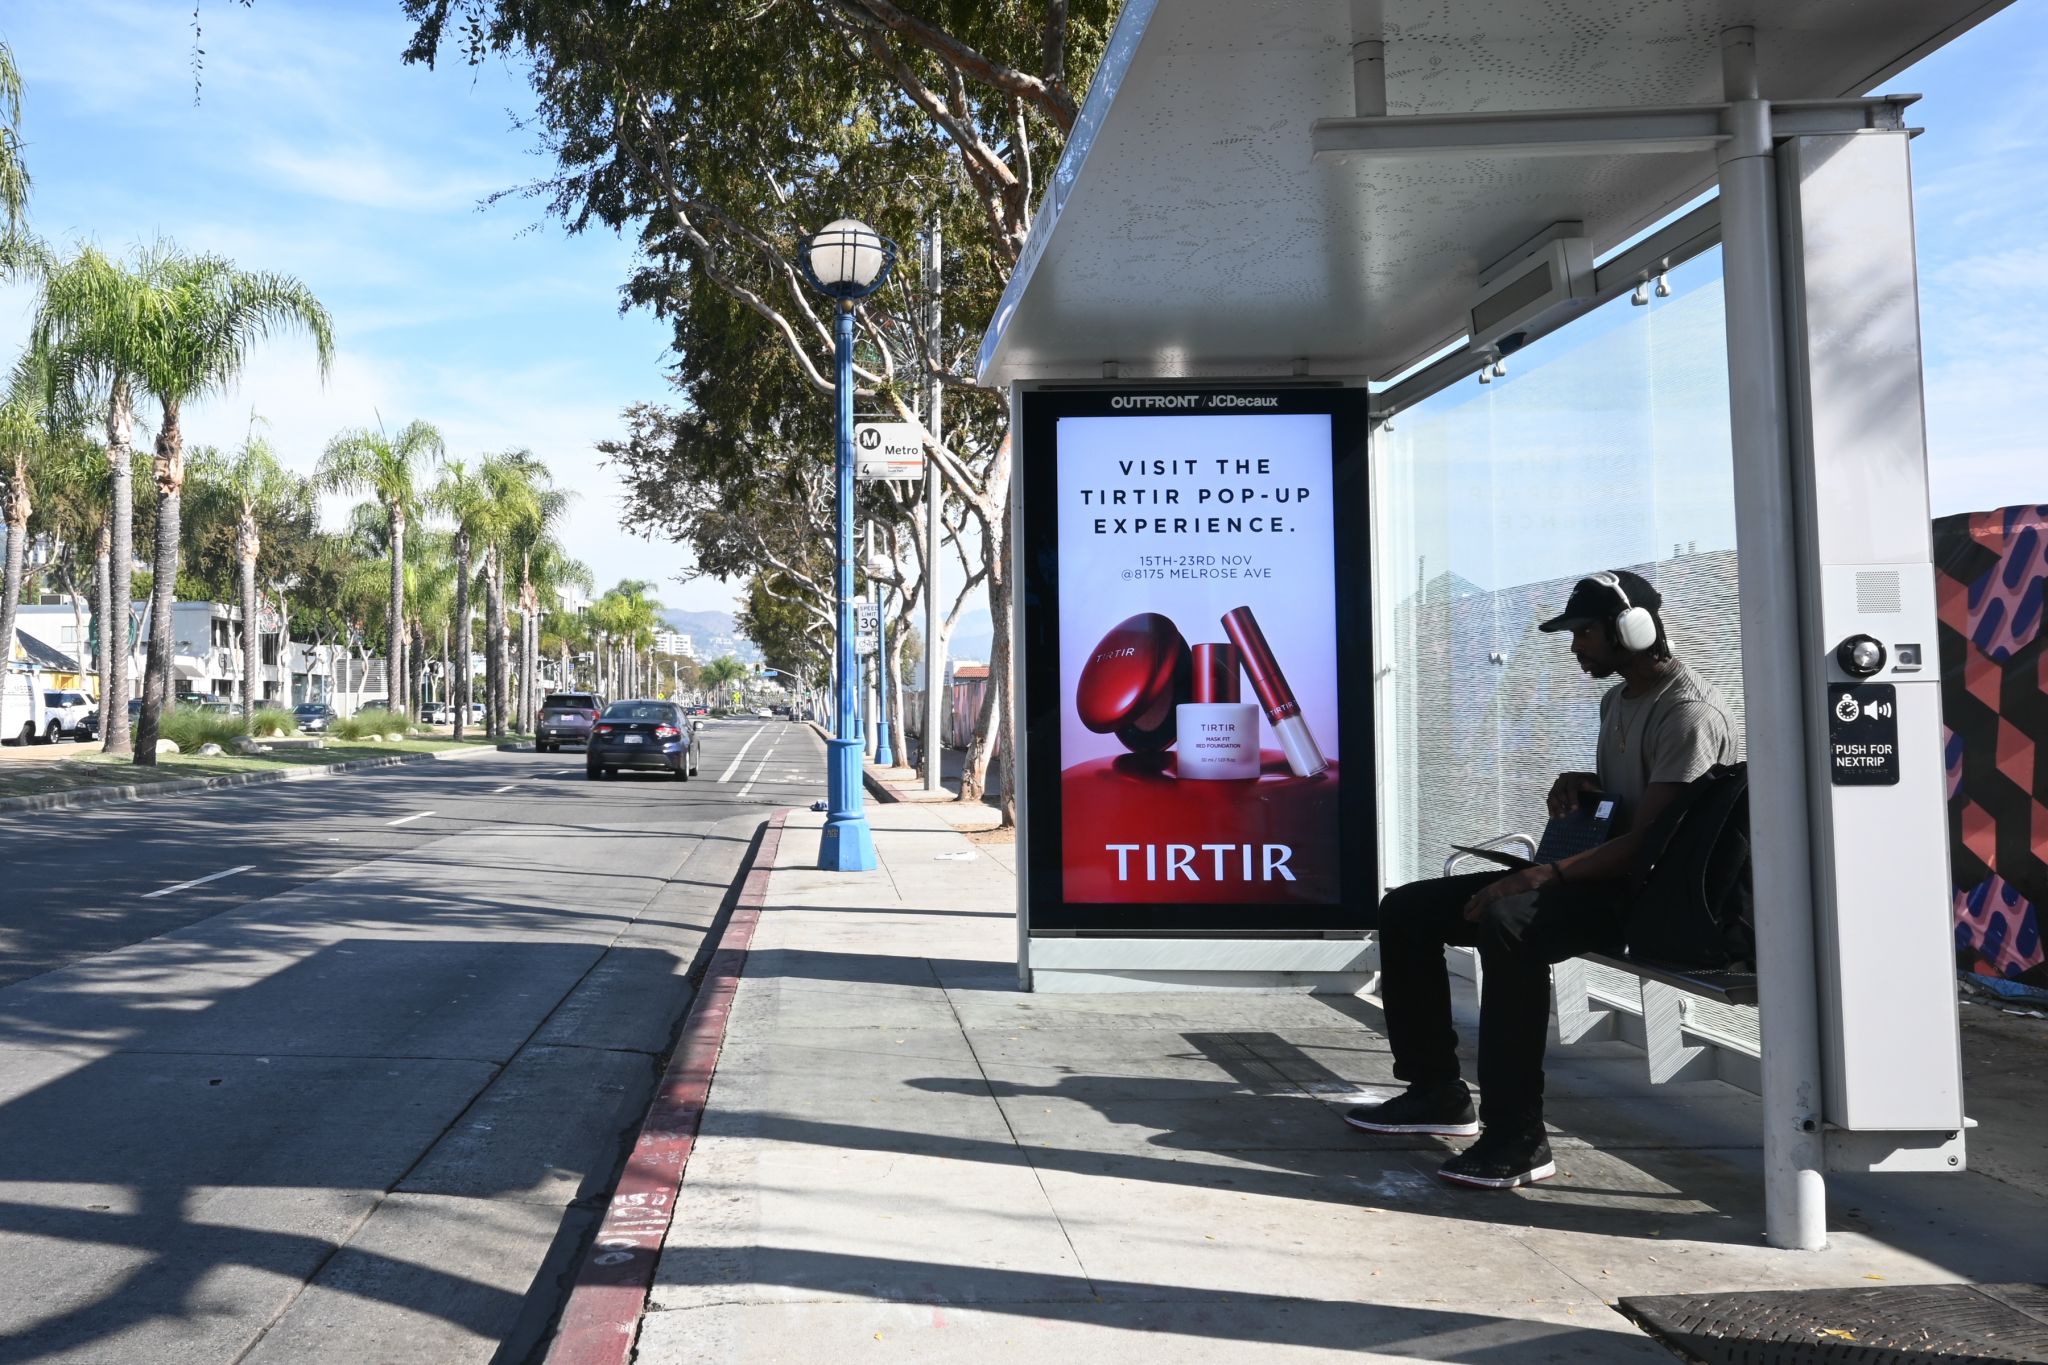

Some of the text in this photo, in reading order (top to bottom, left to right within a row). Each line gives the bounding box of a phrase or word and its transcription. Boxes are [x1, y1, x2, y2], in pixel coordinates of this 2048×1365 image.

[1111, 395, 1278, 408] OUTFRONT JCDecaux
[885, 446, 918, 455] Metro
[862, 464, 870, 475] 4
[1119, 459, 1271, 475] VISIT THE
[1080, 487, 1311, 505] TIRTIR POP-UP
[1094, 517, 1296, 534] EXPERIENCE.
[1139, 555, 1252, 567] 15TH-23RD NOV
[1121, 567, 1272, 581] @8175 MELROSE AVE
[861, 617, 879, 629] 30
[1096, 647, 1135, 663] TIRTIR
[1270, 701, 1294, 716] TIRTIR
[1201, 724, 1236, 732] TIRTIR
[1835, 744, 1893, 755] PUSH FOR
[1836, 757, 1885, 767] NEXTRIP
[1105, 844, 1297, 881] TIRTIR
